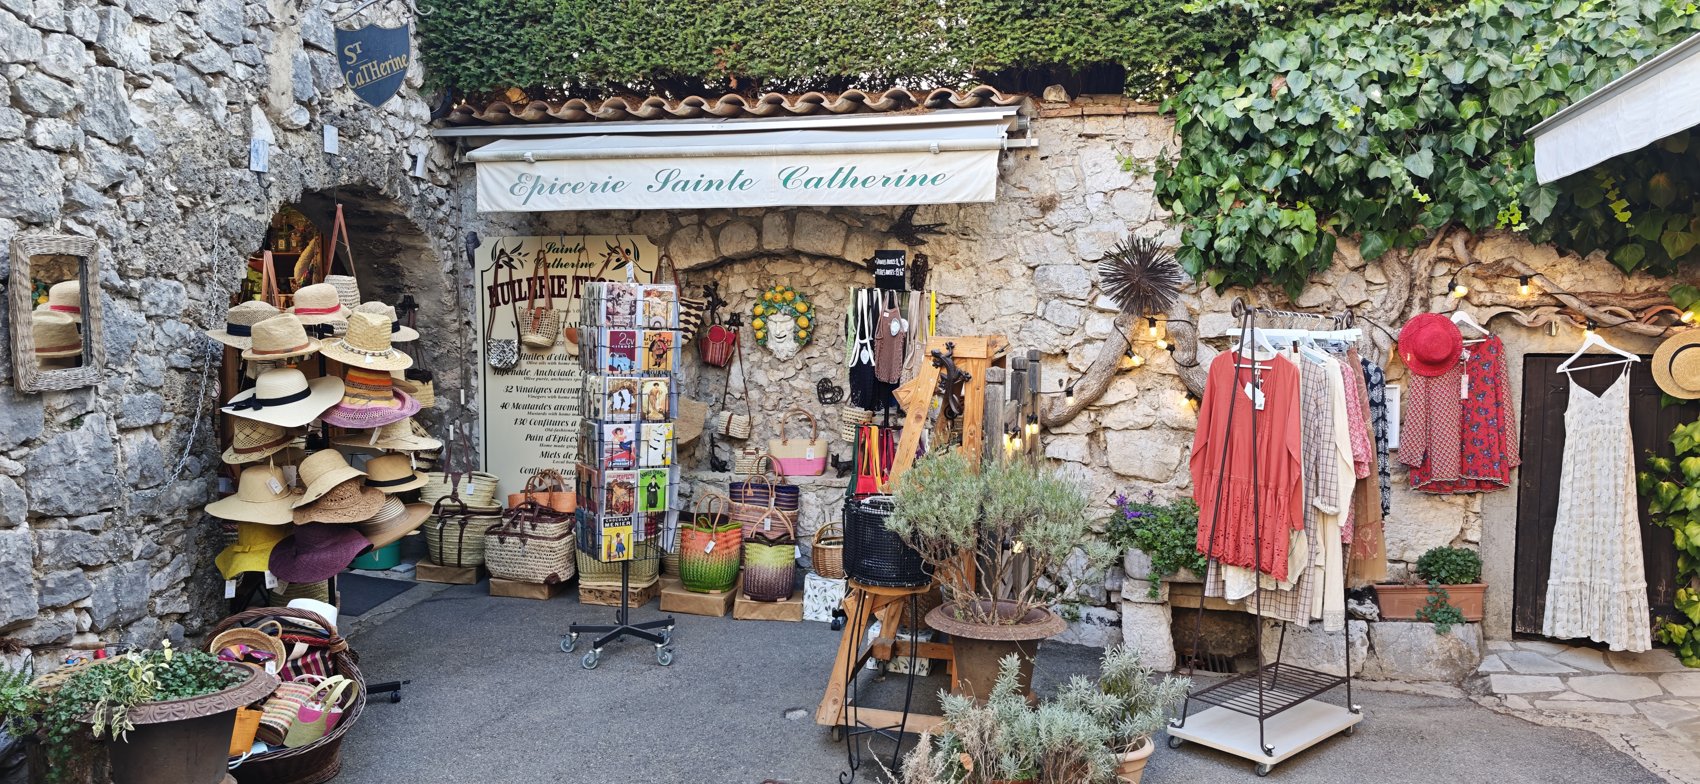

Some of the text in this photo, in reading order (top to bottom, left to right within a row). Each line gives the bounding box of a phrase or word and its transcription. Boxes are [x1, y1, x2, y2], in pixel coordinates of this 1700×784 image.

[509, 165, 954, 205] Epicerie Sainte Catherine
[544, 242, 586, 254] Sainte
[520, 353, 545, 361] Huiles
[504, 385, 514, 393] 32
[515, 385, 552, 394] Vinaigres
[500, 402, 510, 410] 40
[511, 402, 552, 411] Moutardes
[514, 418, 527, 426] 130
[529, 418, 569, 427] Confitures
[540, 451, 561, 459] Miels
[562, 451, 573, 460] de
